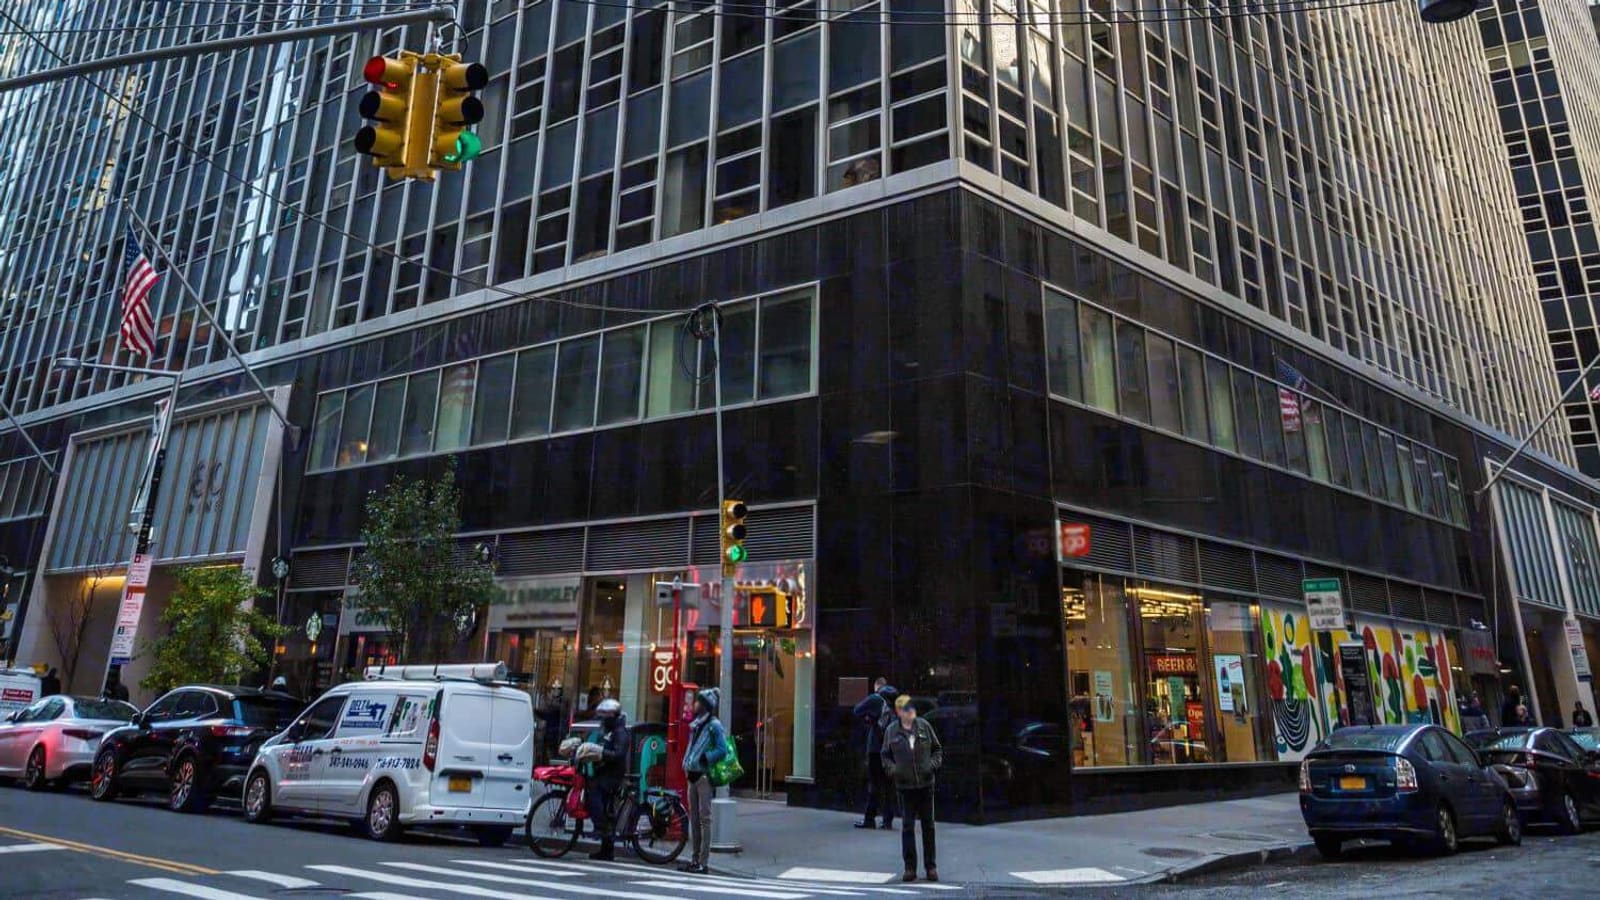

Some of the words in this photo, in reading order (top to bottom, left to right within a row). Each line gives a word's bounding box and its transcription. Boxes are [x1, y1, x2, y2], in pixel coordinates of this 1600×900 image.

[1310, 607, 1341, 617] SHARED
[1314, 617, 1337, 627] LANE
[1157, 657, 1185, 672] BEER
